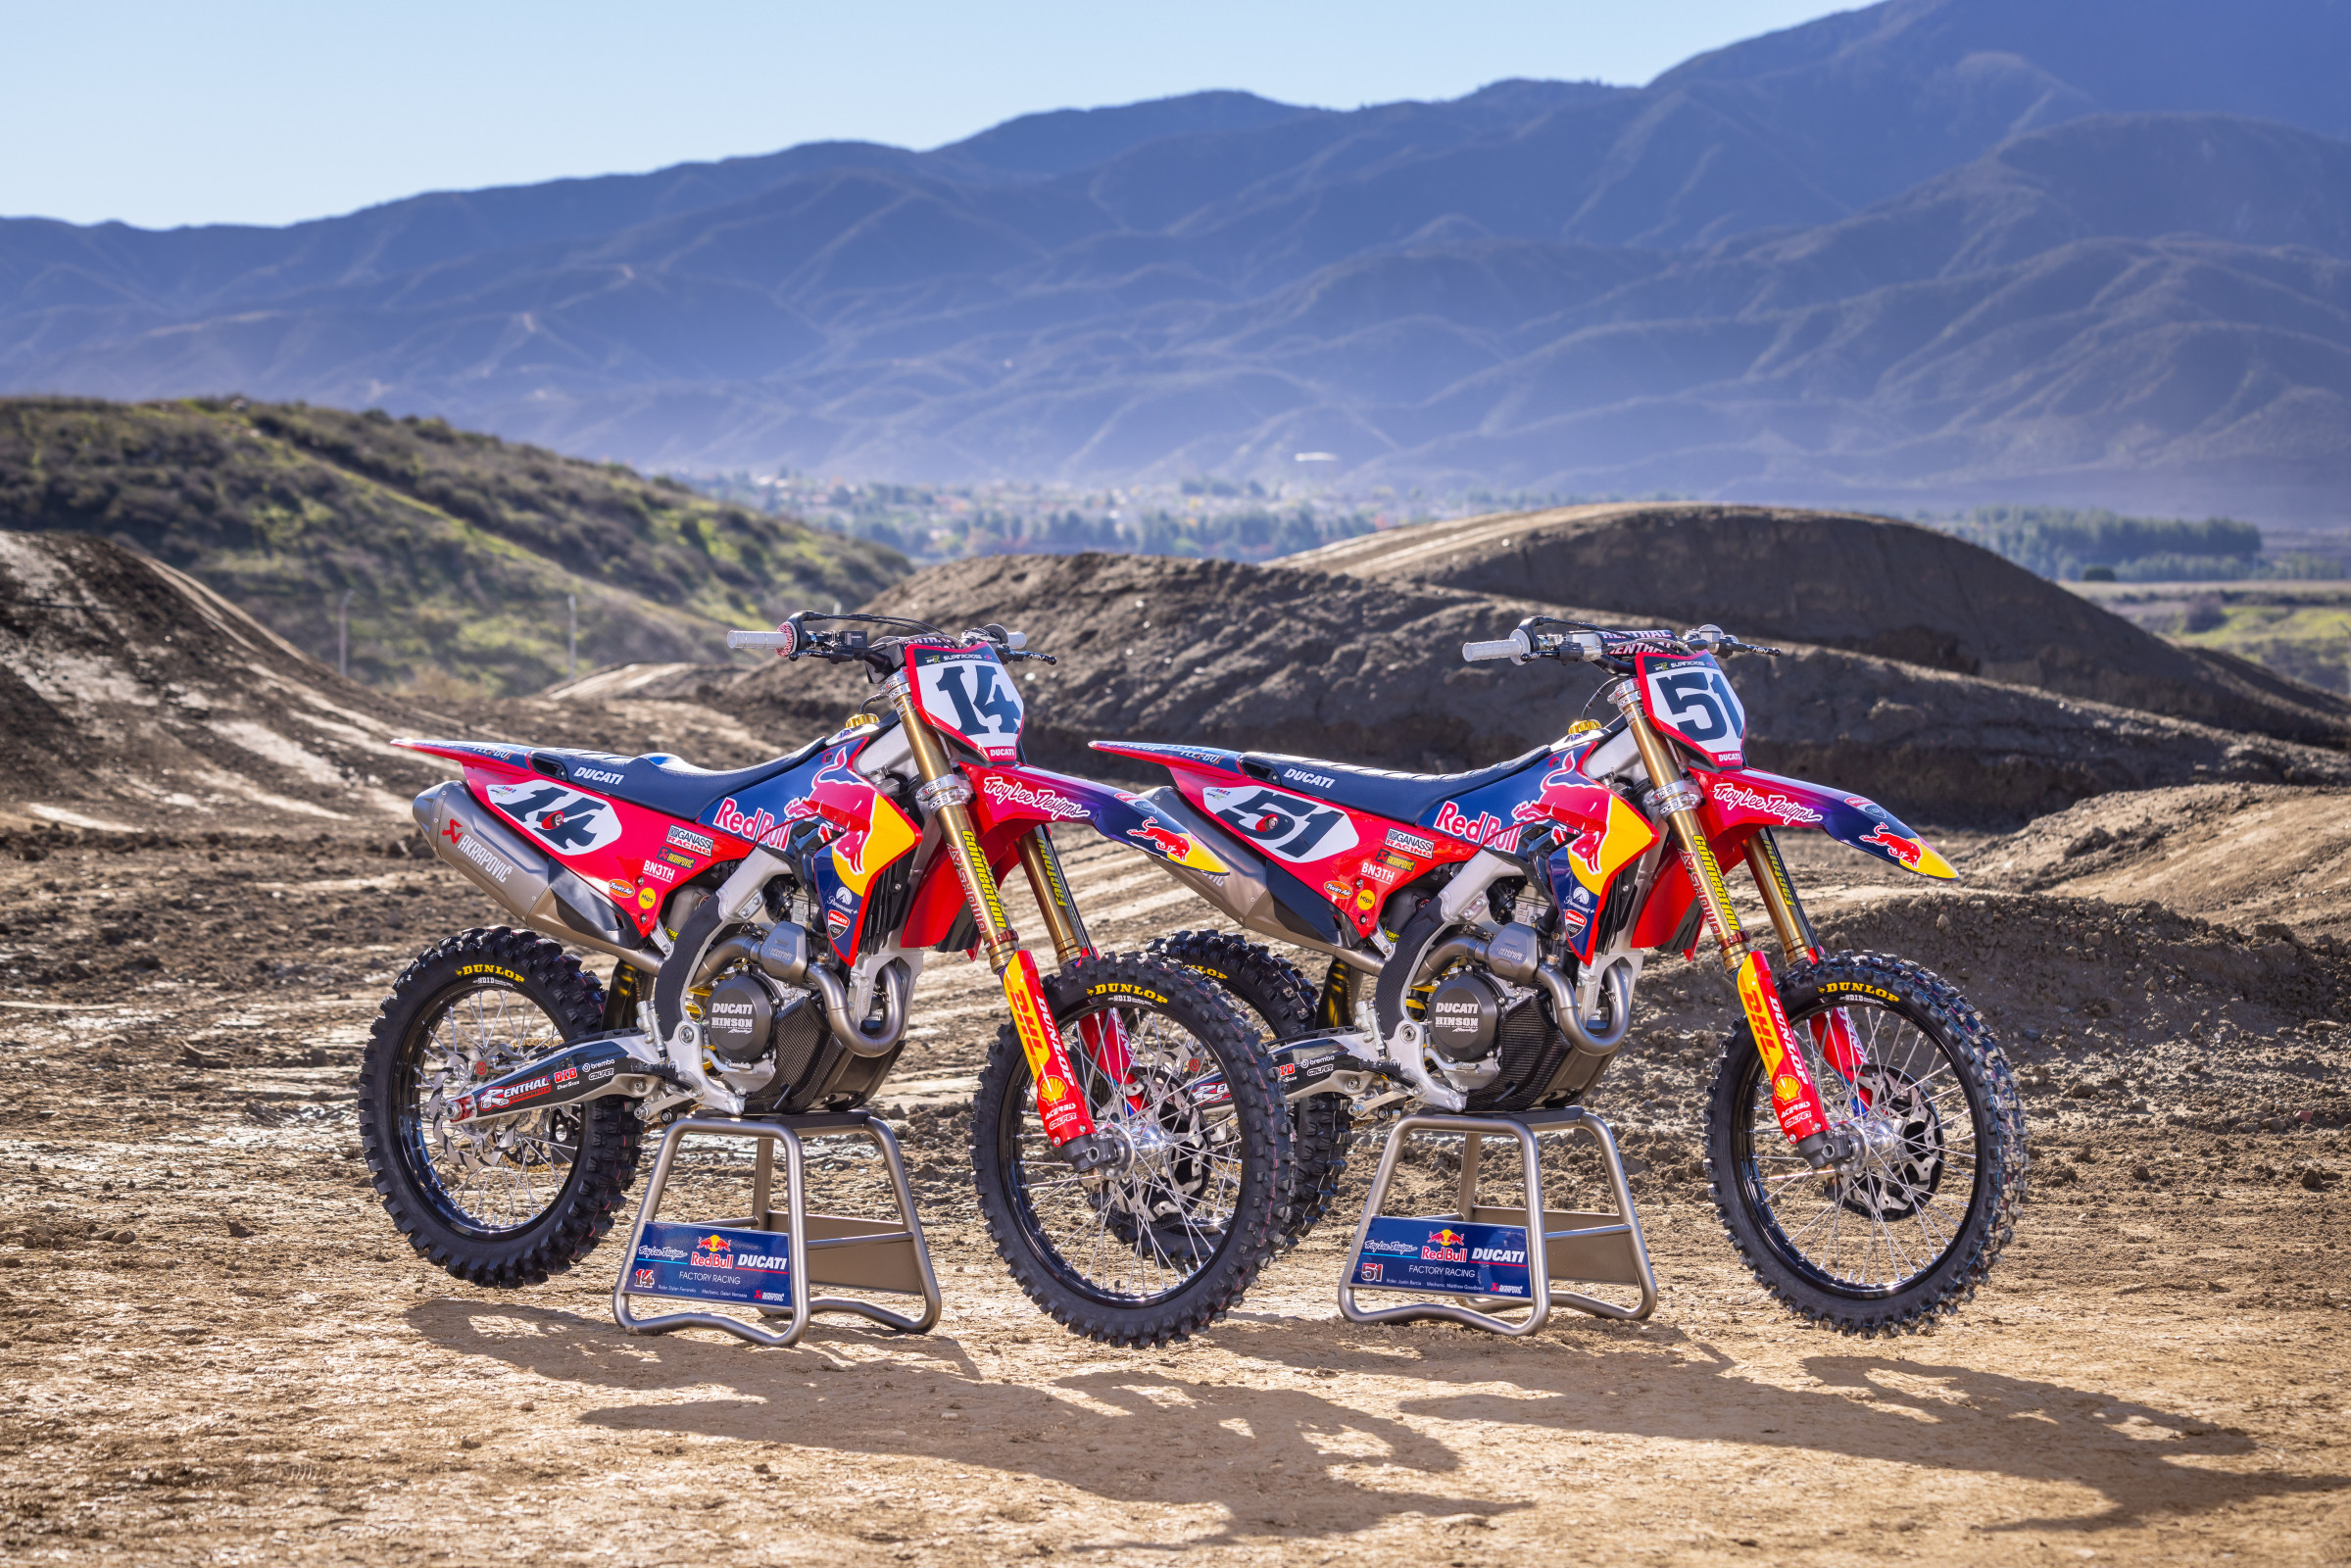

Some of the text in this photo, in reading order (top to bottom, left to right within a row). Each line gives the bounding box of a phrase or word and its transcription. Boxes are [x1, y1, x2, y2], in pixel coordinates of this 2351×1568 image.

[935, 664, 1022, 735] 14
[1655, 672, 1743, 743] 51
[990, 748, 1014, 758] DUCATI
[1718, 753, 1741, 762] DUCATI
[573, 766, 625, 785] DUCATI
[1283, 767, 1336, 789] DUCATI
[983, 776, 1091, 820] Troy Lee Designs
[1714, 783, 1823, 825] Troy Lee Designs
[494, 786, 608, 851] 14
[712, 797, 795, 852] Red Bull
[1215, 789, 1346, 858] 51
[1433, 800, 1524, 855] Red Bull
[666, 836, 710, 856] RACING
[677, 829, 713, 850] GANASSI
[1386, 839, 1432, 858] RACING
[1396, 833, 1434, 853] GANASSI
[457, 834, 513, 883] AKRAPOVIČ
[643, 859, 676, 880] BN3TH
[1361, 861, 1396, 883] BN3TH
[610, 882, 634, 896] Twin Air
[1326, 883, 1341, 894] Twin
[641, 894, 654, 903] Mips
[1359, 895, 1373, 905] Mips
[829, 912, 848, 924] DUCATI
[1567, 911, 1585, 924] DUCATI
[463, 964, 524, 983] DUNLOP
[1094, 983, 1169, 1004] DUNLOP
[1826, 982, 1900, 1003] DUNLOP
[711, 1003, 753, 1015] DUCATI
[1435, 1003, 1479, 1014] DUCATI
[711, 1017, 753, 1027] HINSON
[1010, 989, 1043, 1056] DHL
[1435, 1016, 1479, 1026] HINSON
[1743, 990, 1777, 1056] DHL
[1036, 995, 1075, 1087] DUNLOP
[1769, 995, 1809, 1085] DUNLOP
[590, 1058, 615, 1069] brembo
[1309, 1055, 1335, 1065] brembo
[554, 1067, 577, 1084] DID
[1277, 1063, 1296, 1077] ID
[1045, 1102, 1076, 1120] ACERBIS
[1781, 1102, 1811, 1119] ACERBIS
[691, 1251, 734, 1269] Red Bull
[737, 1253, 787, 1270] DUCATI
[1421, 1246, 1468, 1263] Red Bull
[1471, 1247, 1526, 1263] DUCATI
[634, 1268, 655, 1289] 14
[678, 1271, 741, 1285] FACTORY RACING
[1360, 1262, 1384, 1283] 51
[1408, 1264, 1476, 1278] FACTORY RACING
